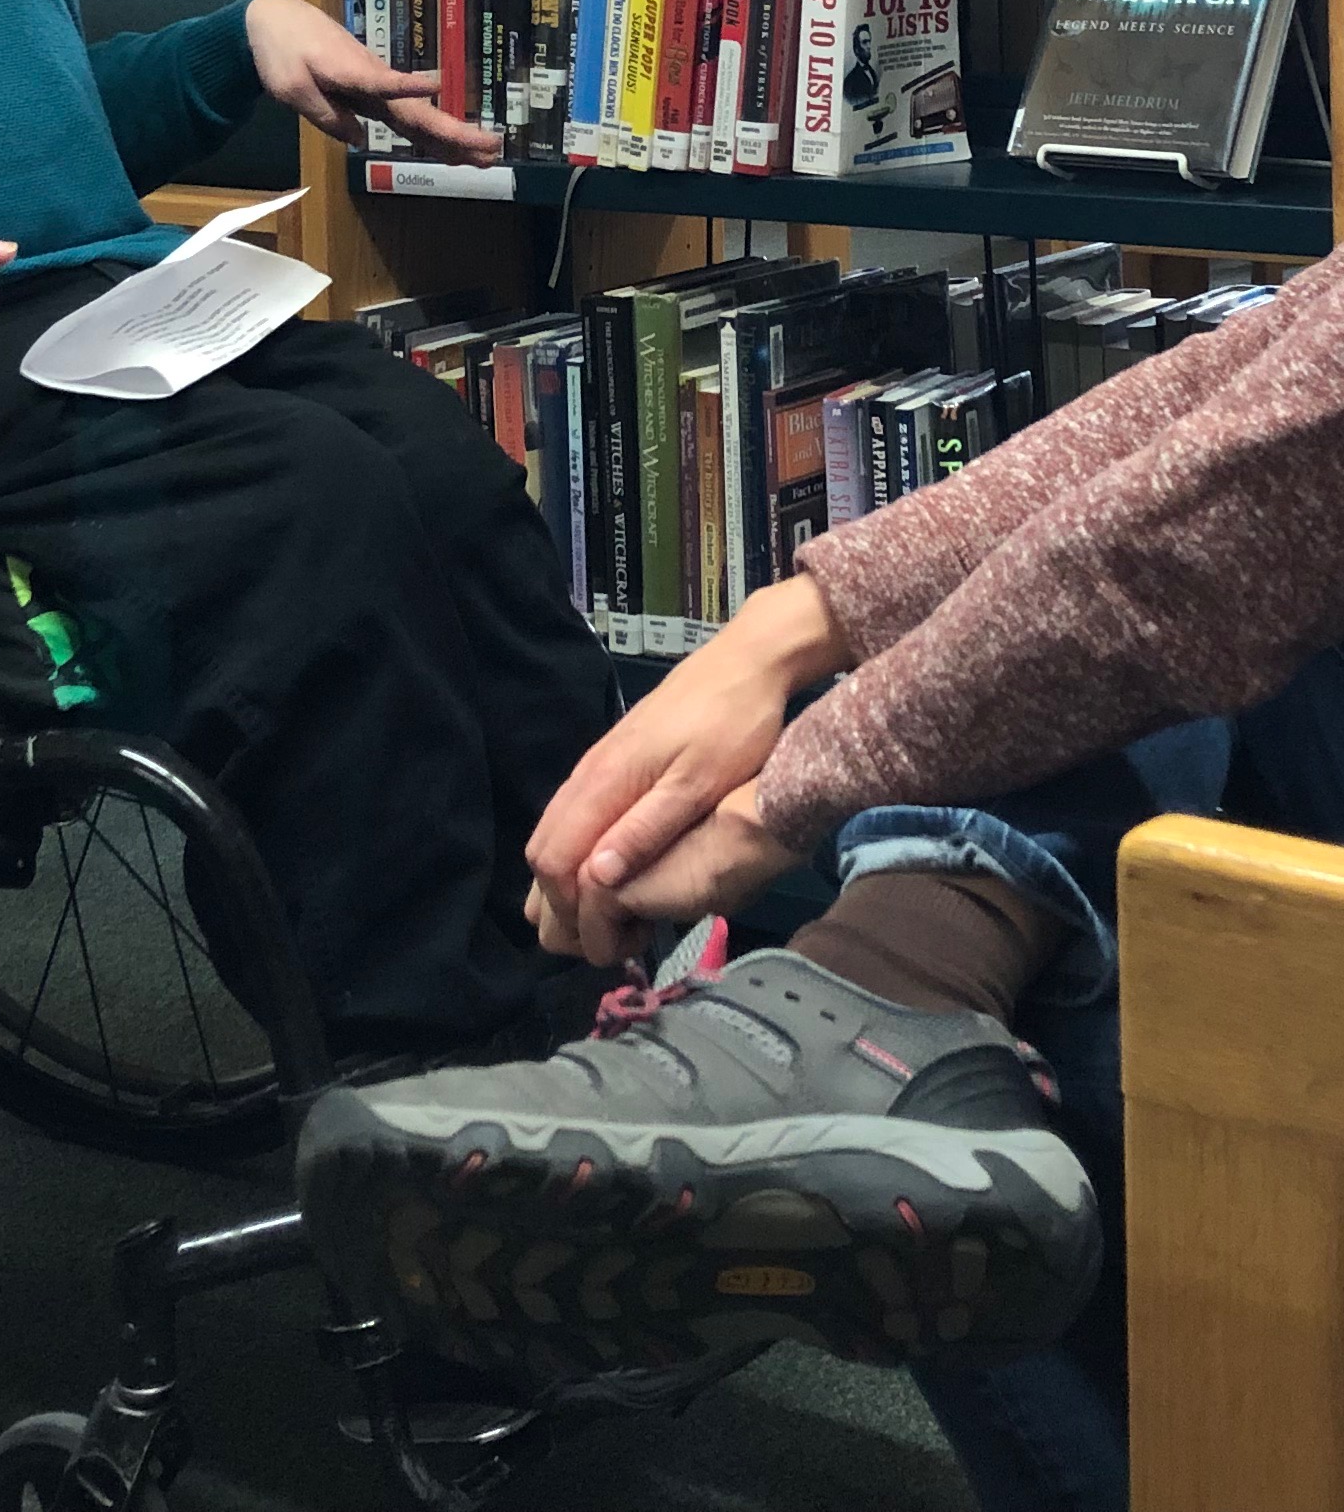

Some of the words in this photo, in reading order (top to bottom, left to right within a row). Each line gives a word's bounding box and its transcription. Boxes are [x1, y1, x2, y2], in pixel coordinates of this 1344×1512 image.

[482, 12, 492, 54] BEYOND
[613, 13, 624, 24] DO
[760, 4, 771, 39] BOOK
[809, 18, 836, 47] 10
[886, 11, 950, 40] LISTS
[1055, 19, 1110, 31] LEGEND
[1117, 21, 1165, 33] MEETS
[1174, 24, 1236, 36] SCIENCE
[610, 26, 623, 59] CLOCKS
[625, 13, 642, 95] SCANDALOUS!
[482, 58, 493, 85] STAR
[640, 45, 654, 81] POP!
[604, 78, 619, 119] CLOCKWIS
[697, 63, 709, 103] CURIOUS
[804, 55, 834, 133] LISTS
[1068, 92, 1101, 106] JEFF
[1103, 93, 1180, 110] MELDRUM
[396, 174, 434, 187] Oddities
[788, 412, 823, 436] Blac
[610, 421, 624, 497] WITCHES
[792, 449, 813, 463] and
[827, 425, 850, 490] EXTRA
[872, 438, 888, 507] APPARIT
[571, 488, 583, 515] Deal
[792, 484, 814, 500] Fact
[830, 494, 852, 528] SEN
[613, 512, 628, 613] WITCHCRAF
